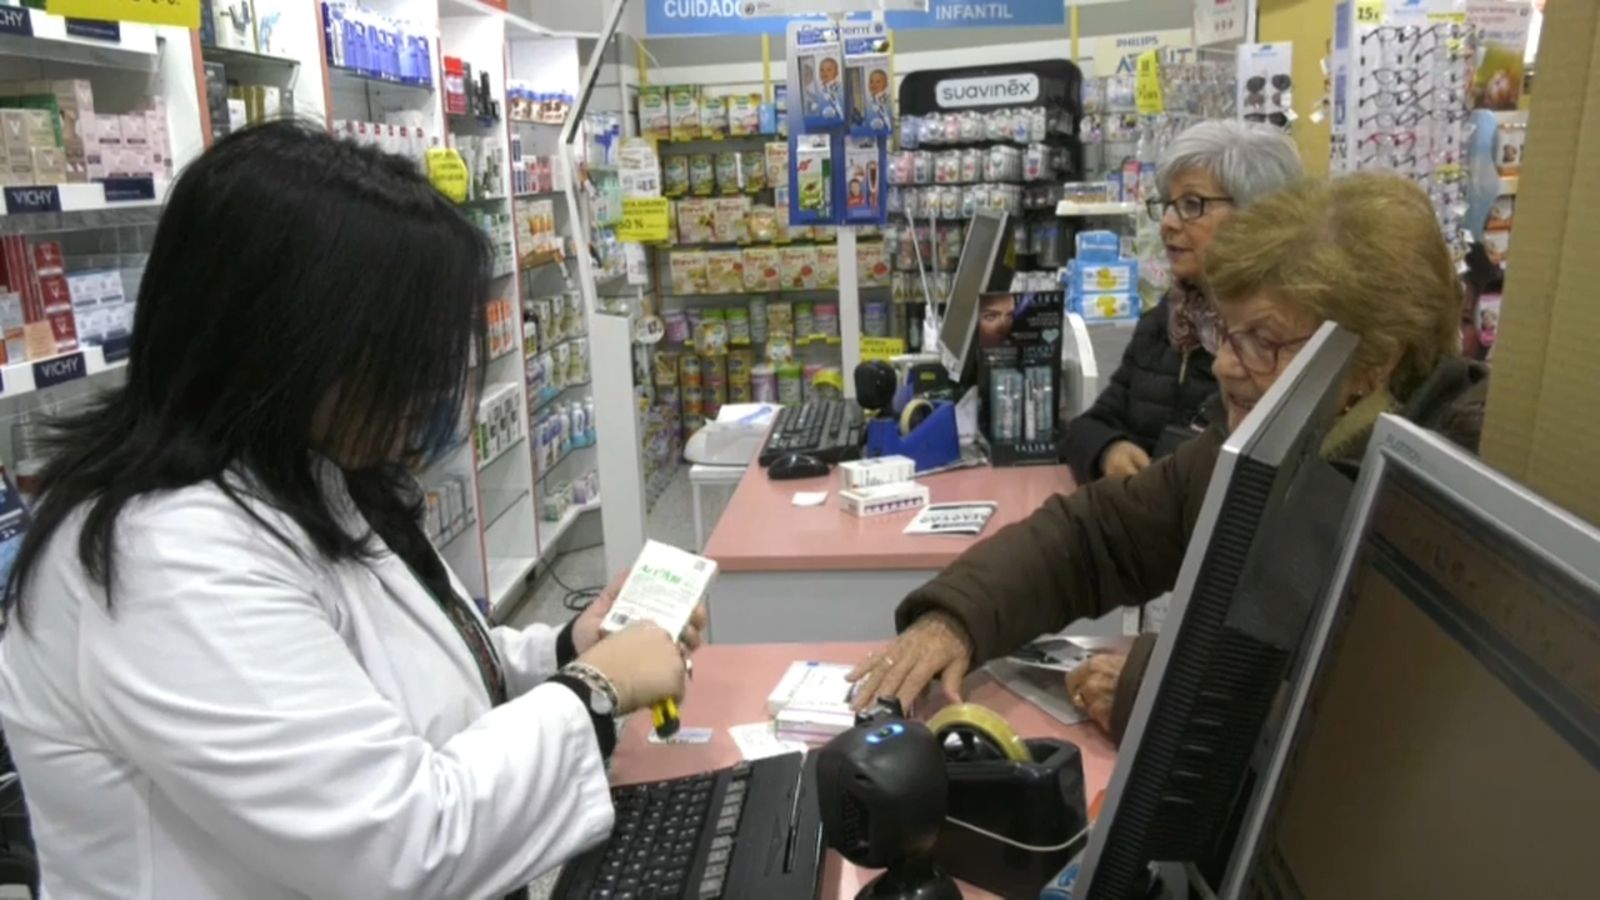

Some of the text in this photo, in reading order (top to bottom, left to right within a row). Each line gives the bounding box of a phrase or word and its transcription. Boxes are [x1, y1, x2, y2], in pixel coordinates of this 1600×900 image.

[936, 3, 1013, 20] INFANTIL
[13, 190, 52, 206] VICHY
[42, 357, 79, 378] VICHY
